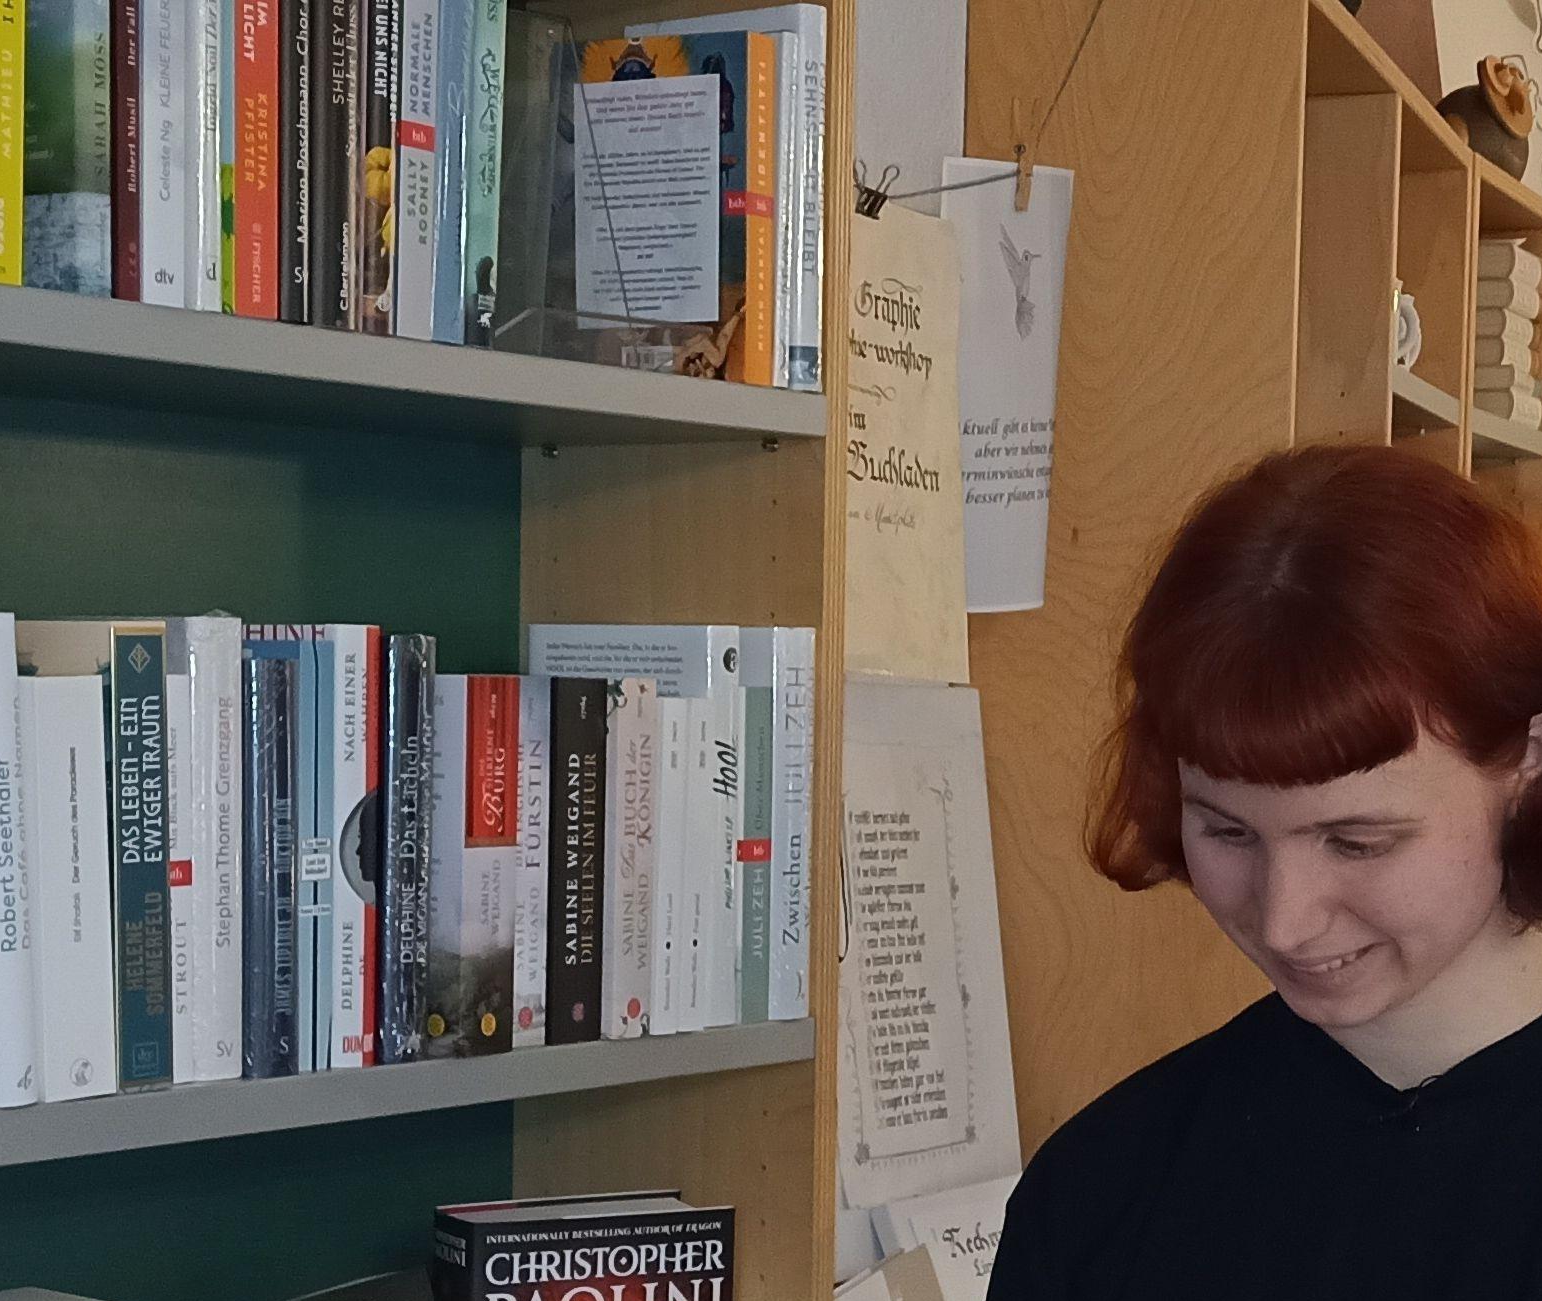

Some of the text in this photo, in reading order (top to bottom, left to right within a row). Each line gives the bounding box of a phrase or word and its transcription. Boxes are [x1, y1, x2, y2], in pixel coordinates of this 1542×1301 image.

[93, 30, 109, 178] SARAH MOSS
[408, 21, 421, 114] NORMALE
[420, 12, 433, 117] MENSCHEN
[407, 158, 418, 218] SALLY
[418, 159, 429, 246] ROONEY
[847, 438, 940, 493] Buchladen
[343, 653, 356, 763] NACH EINER
[119, 696, 141, 864] DAS LEBEN EIN
[141, 694, 163, 863] EWIGER TRAUM
[215, 695, 233, 948] Stephan Thome Grenzgang
[480, 870, 491, 927] SABINE
[565, 752, 580, 965] SABINE WEIGAND
[781, 834, 802, 946] Zwischen
[0, 877, 18, 953] Robert
[175, 918, 188, 1016] STROUT
[340, 921, 354, 1011] DELPHINE
[484, 1239, 726, 1287] CHRISTOPHER
[485, 1230, 570, 1245] INTERNATIONALLY
[571, 1226, 632, 1241] BESTSELLING
[632, 1223, 670, 1237] AUTHOR
[670, 1222, 685, 1235] OF
